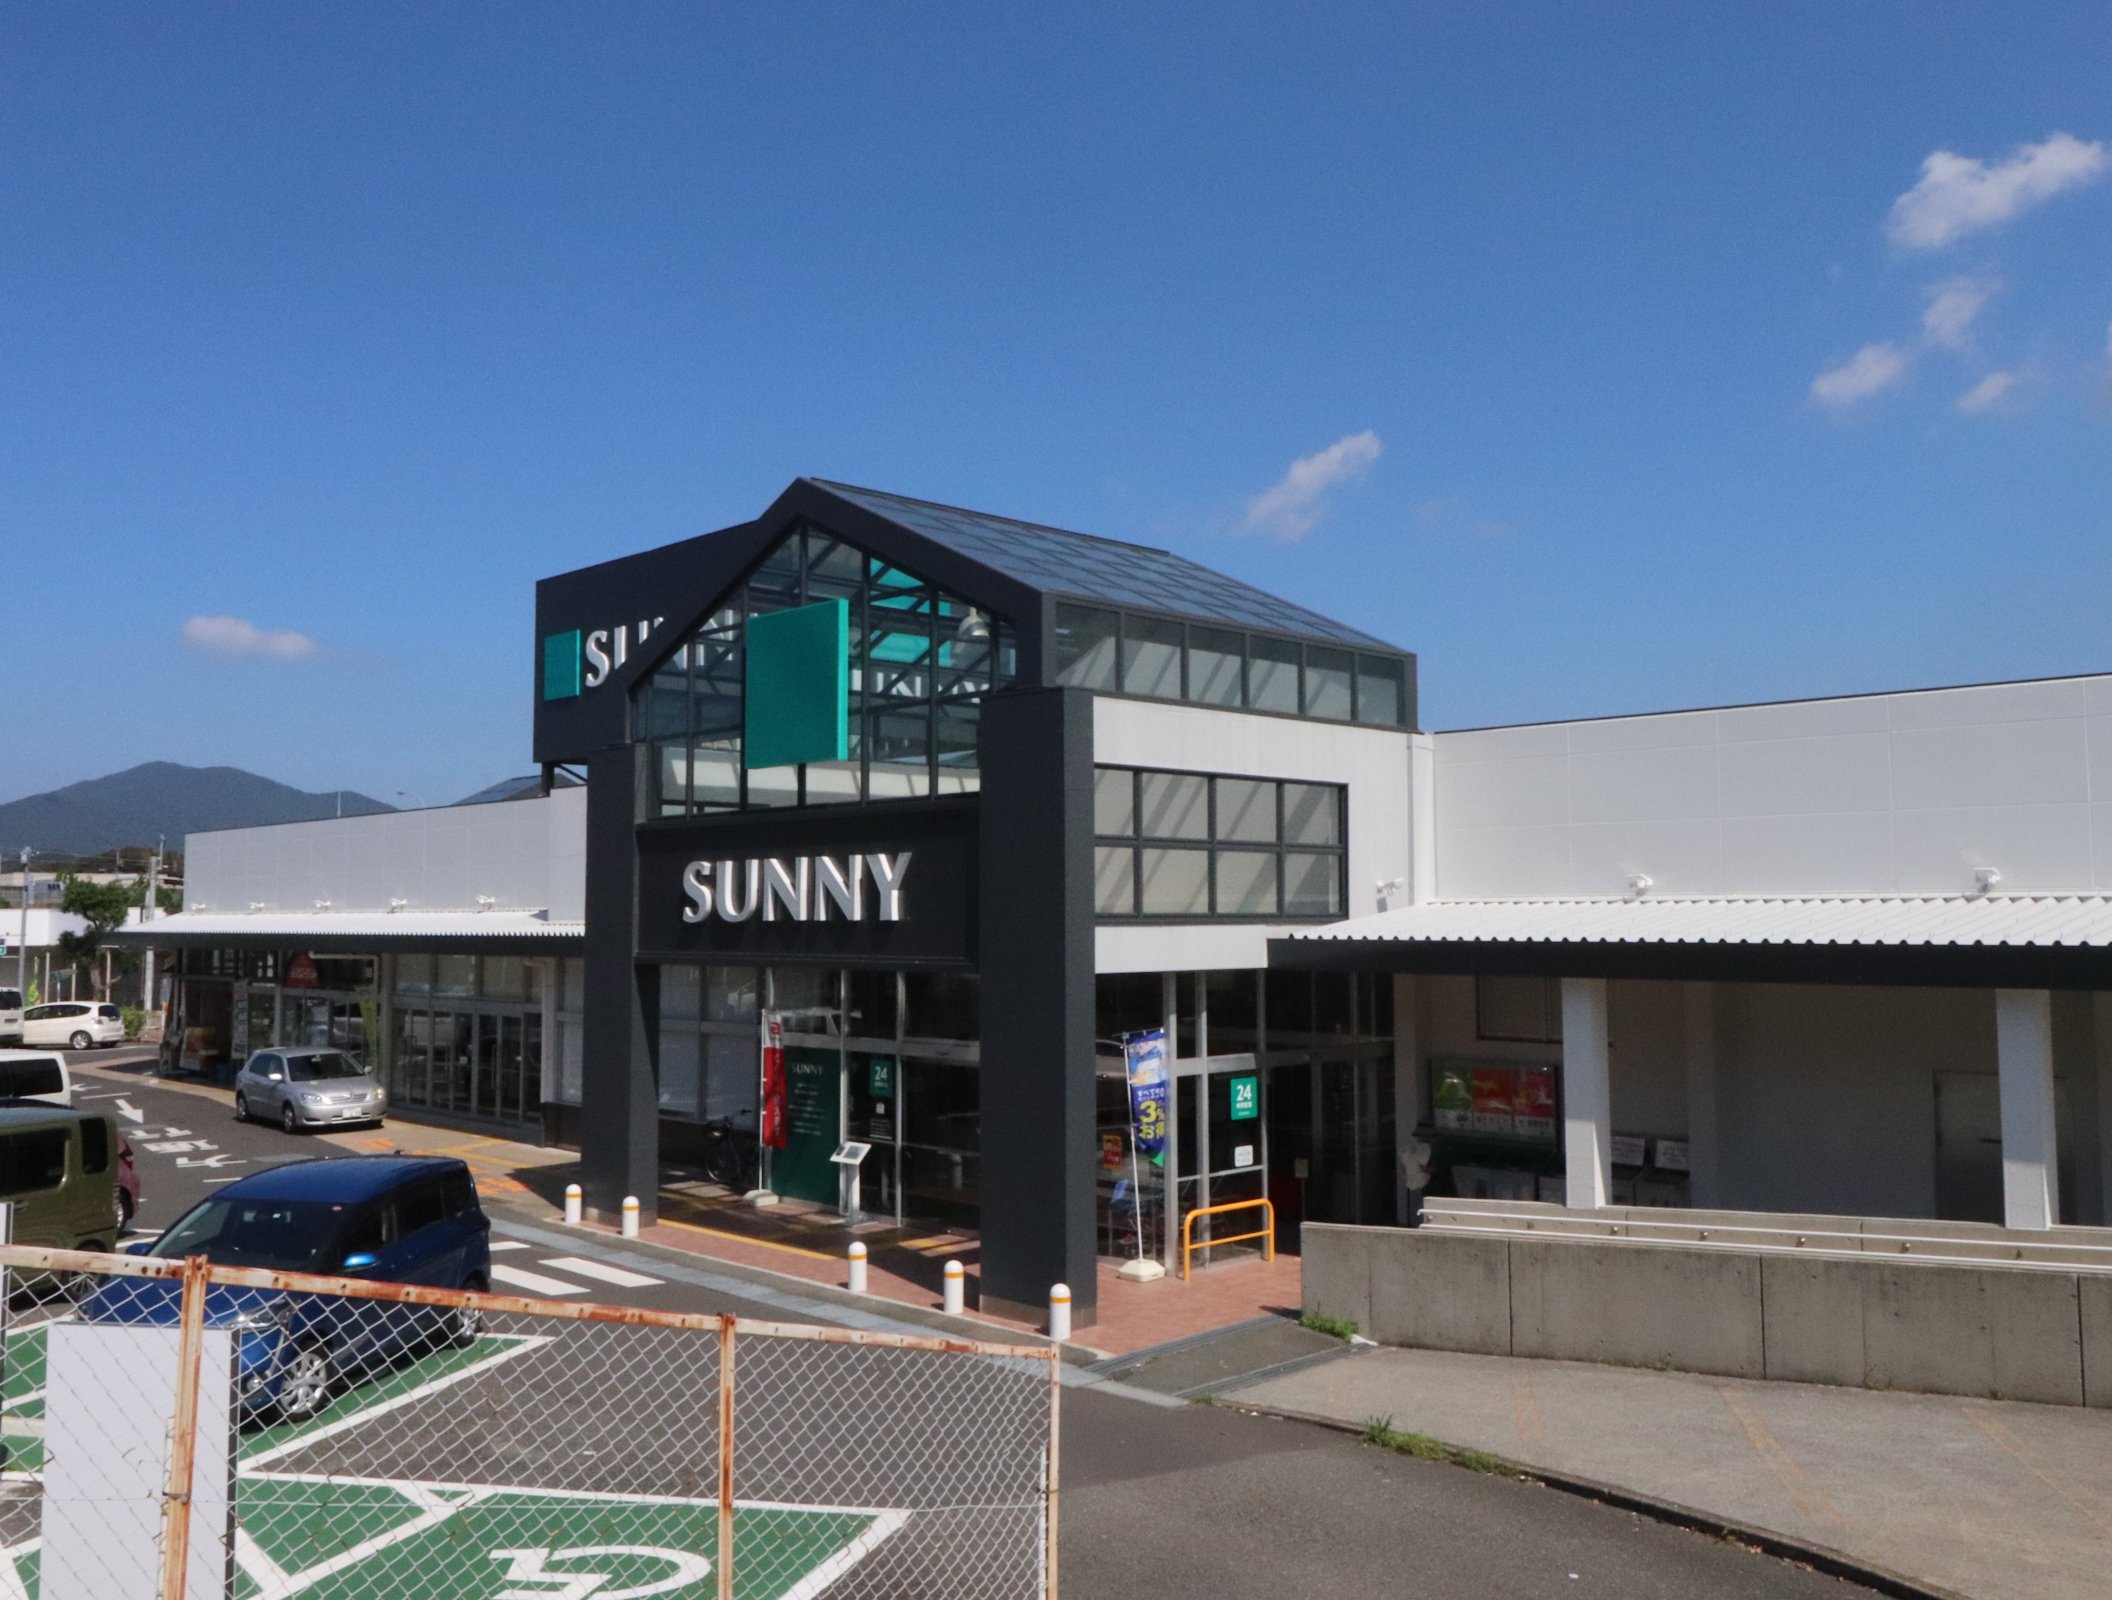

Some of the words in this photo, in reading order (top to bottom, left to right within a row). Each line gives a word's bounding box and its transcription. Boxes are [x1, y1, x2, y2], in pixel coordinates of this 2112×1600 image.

[683, 852, 912, 923] SUNNY
[792, 1062, 824, 1076] SUNNY
[874, 1065, 888, 1081] 24
[1236, 1084, 1252, 1101] 24
